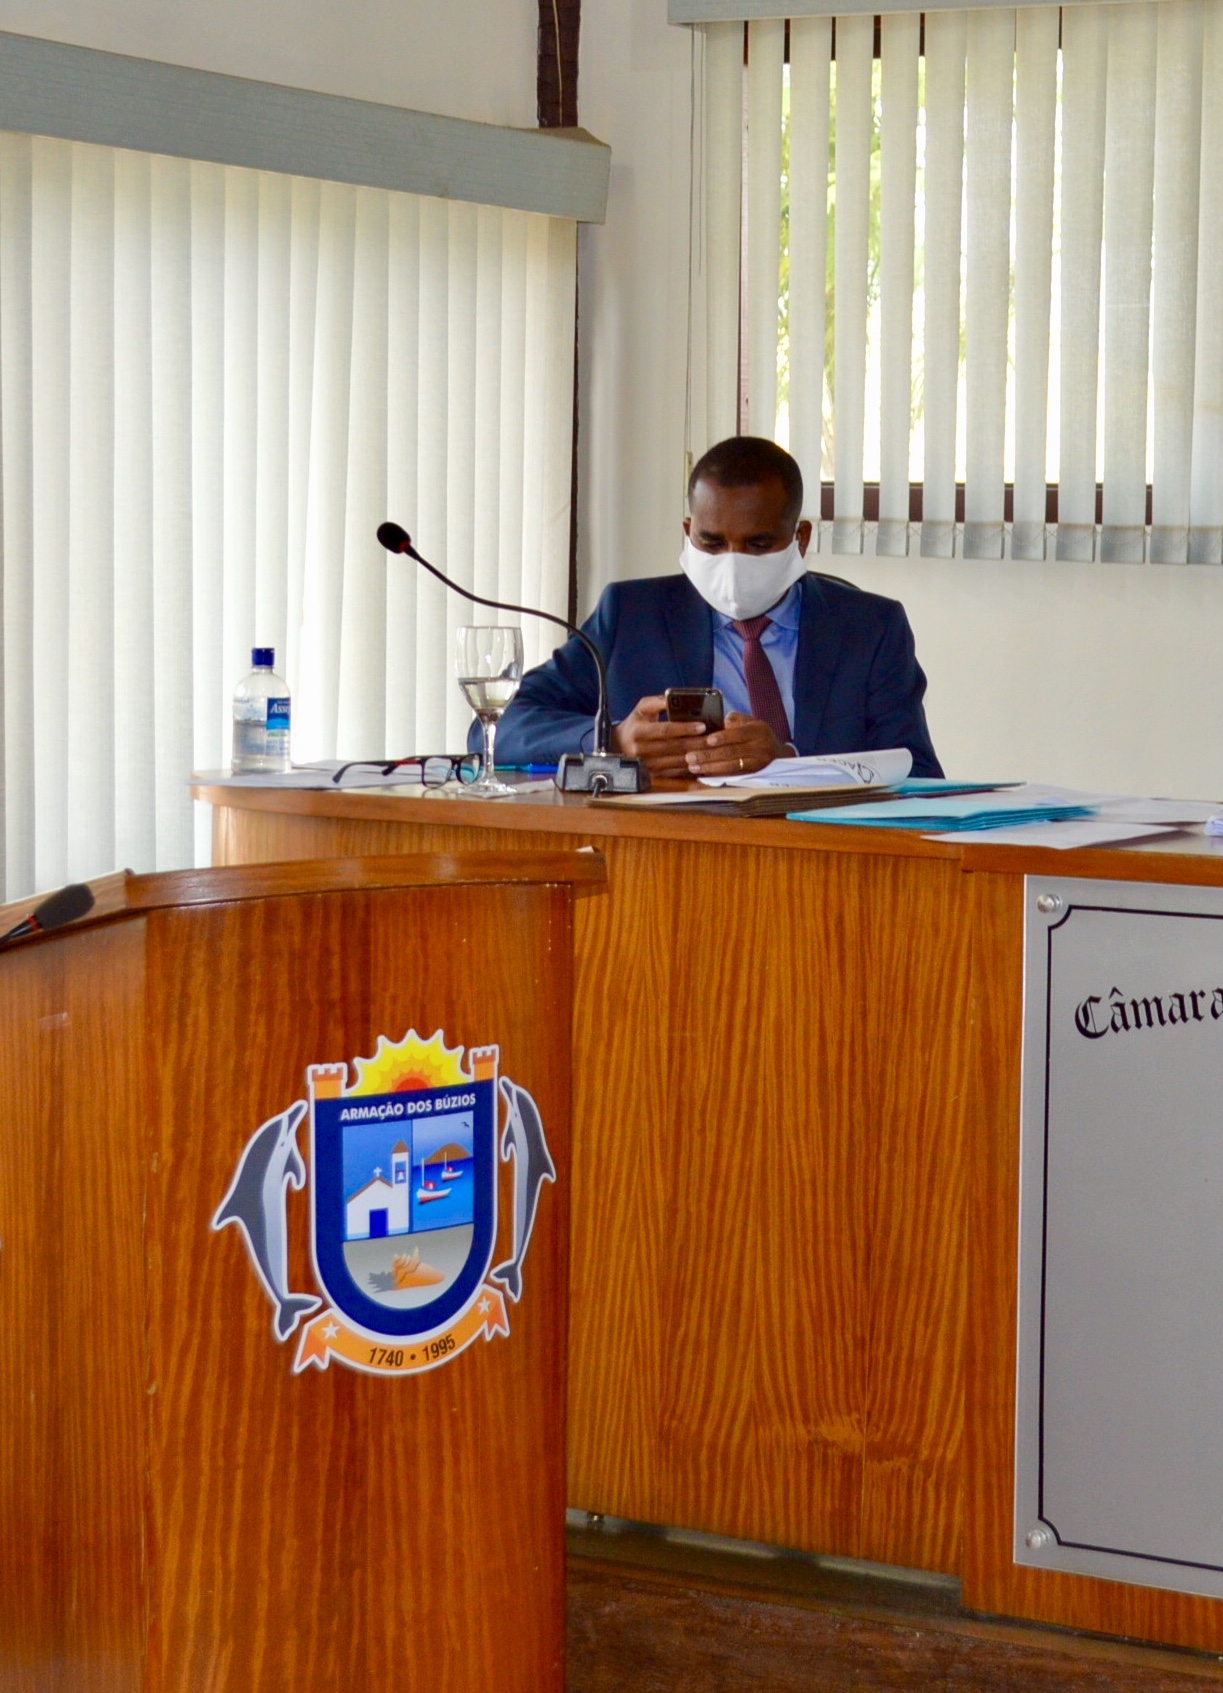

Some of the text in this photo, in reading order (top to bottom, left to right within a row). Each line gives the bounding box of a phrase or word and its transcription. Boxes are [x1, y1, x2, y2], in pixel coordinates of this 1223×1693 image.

[340, 1092, 476, 1121] ARMAÇÃO DOS BÚZIOS
[369, 1333, 456, 1367] 1740 1995
